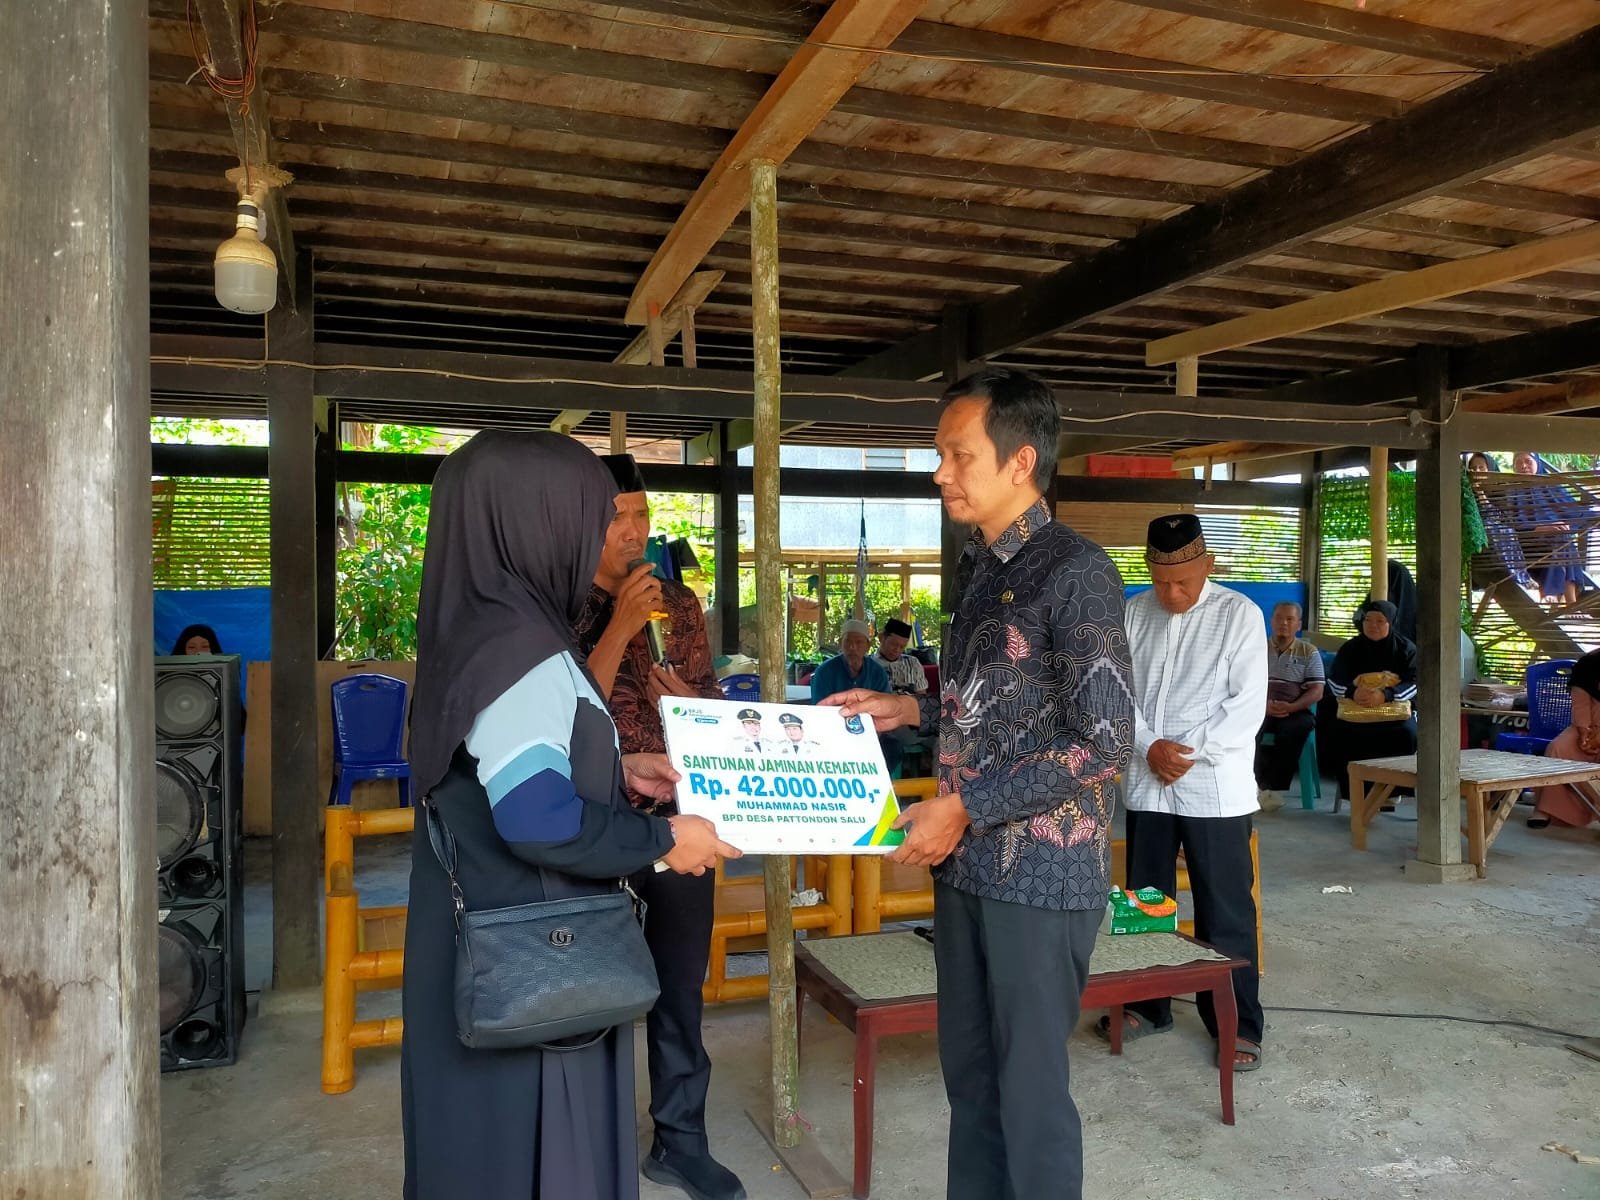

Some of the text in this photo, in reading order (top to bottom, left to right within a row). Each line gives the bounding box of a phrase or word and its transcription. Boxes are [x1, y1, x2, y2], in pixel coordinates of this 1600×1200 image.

[682, 754, 879, 775] SANTUNAN JAMINAN KEMATIAN
[689, 772, 881, 803] Rp. 42.000.000,-
[736, 800, 847, 812] MUHAMMAD NASIR
[722, 813, 866, 824] BPD DESA PATTONDON SALU
